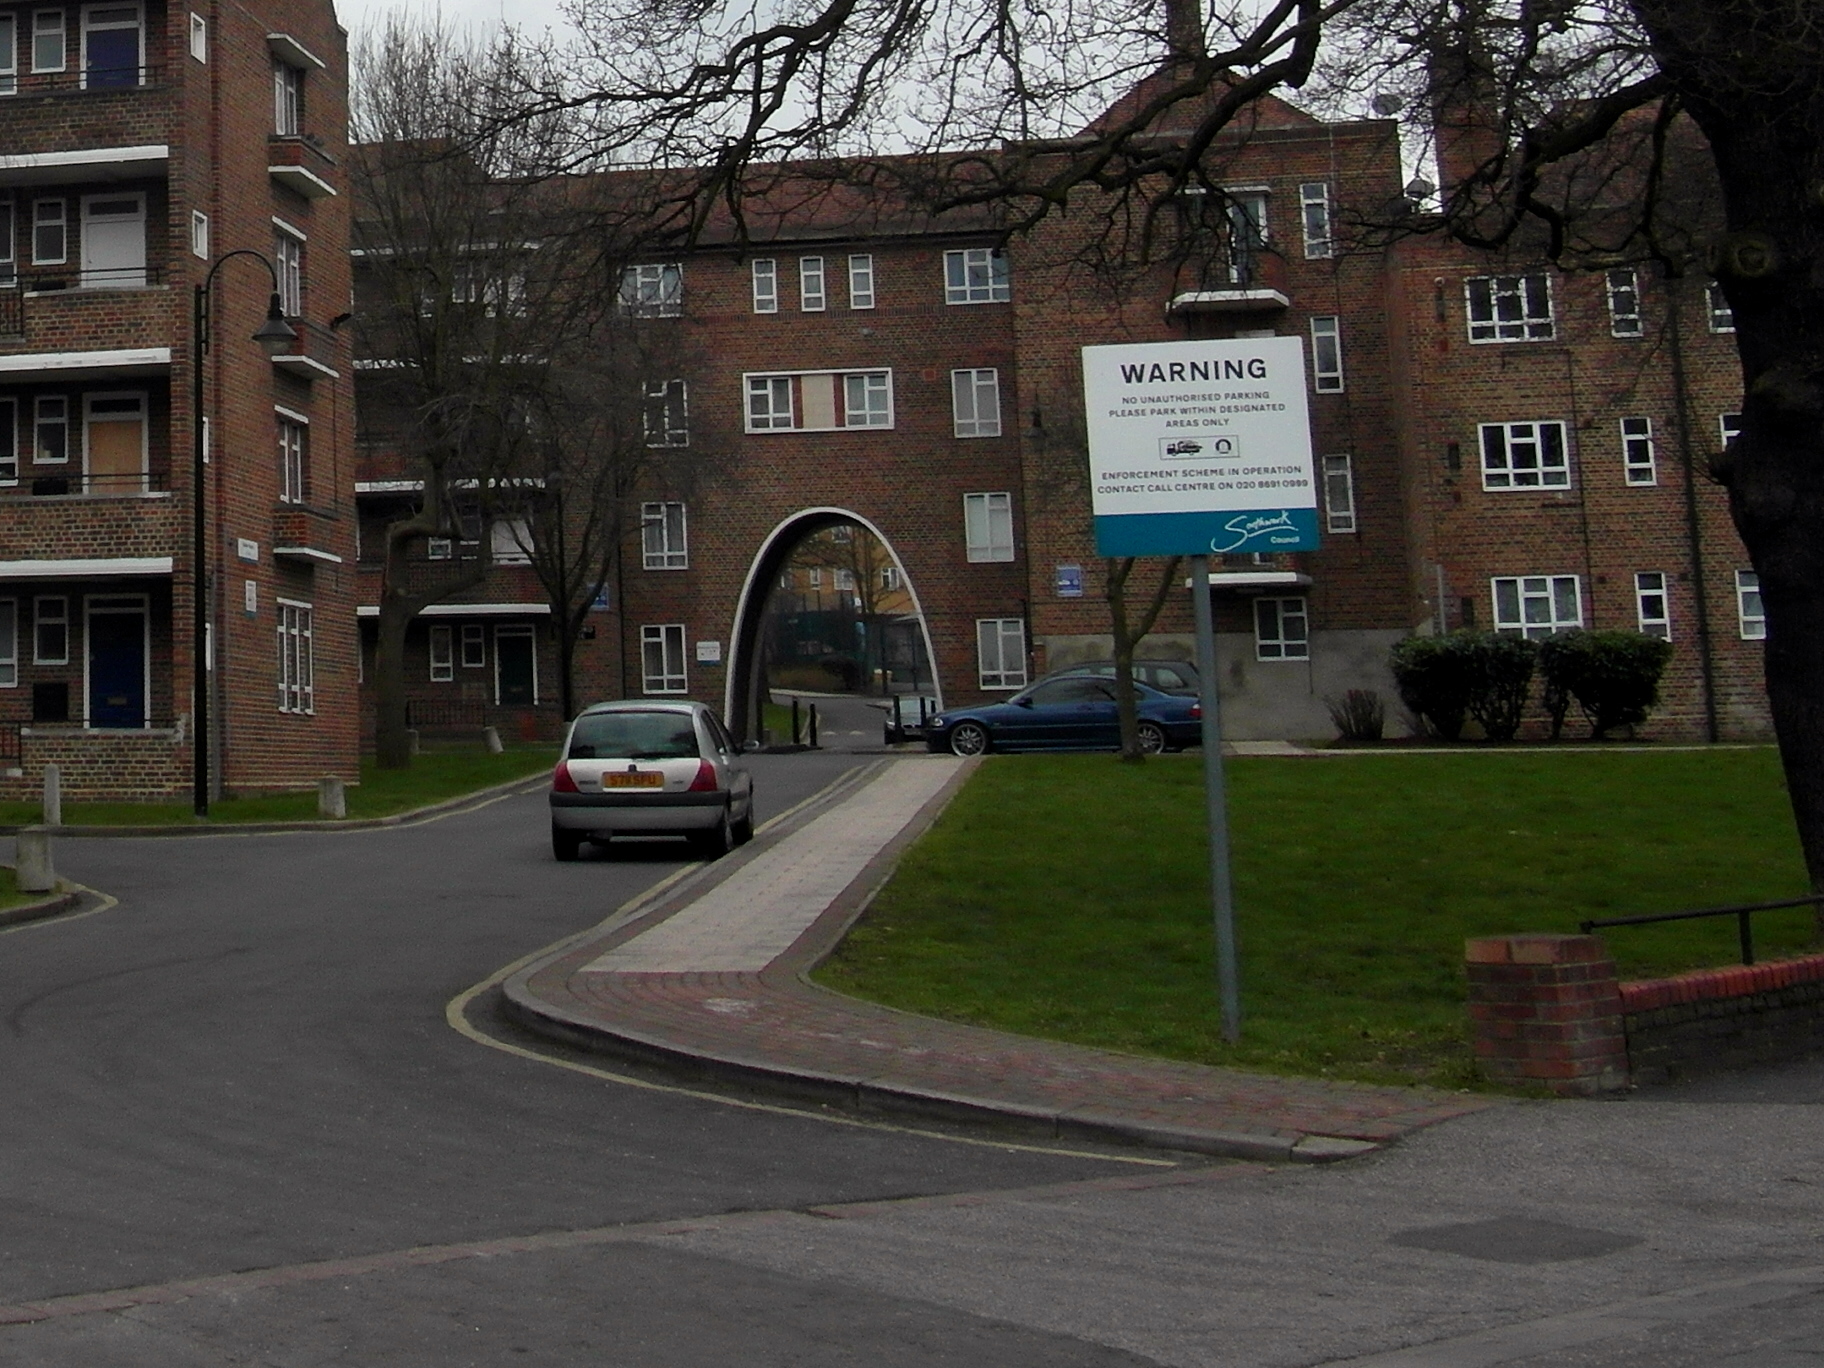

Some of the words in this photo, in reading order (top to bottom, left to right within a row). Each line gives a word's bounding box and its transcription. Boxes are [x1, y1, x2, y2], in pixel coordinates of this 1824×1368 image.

[1120, 358, 1267, 384] WARNING
[1122, 396, 1138, 404] NO
[1140, 393, 1221, 404] UNAUTHORISED
[1224, 391, 1270, 400] PARKING
[1108, 408, 1147, 417] PLEASE
[1150, 408, 1177, 416] PARK
[1179, 406, 1216, 415] WITHIN
[1219, 402, 1285, 413] DESIGNATED
[1166, 419, 1199, 428] AREAS
[1202, 418, 1229, 426] ONLY
[1102, 470, 1179, 480] ENFORCEMENT
[1182, 468, 1225, 477] SCHEME
[1242, 466, 1301, 475] OPERATION
[1097, 485, 1145, 494] CONTACT
[1147, 484, 1173, 492] CALL
[1174, 482, 1216, 491] CENTRE
[1218, 482, 1233, 490] ON
[1236, 481, 1256, 489] 020
